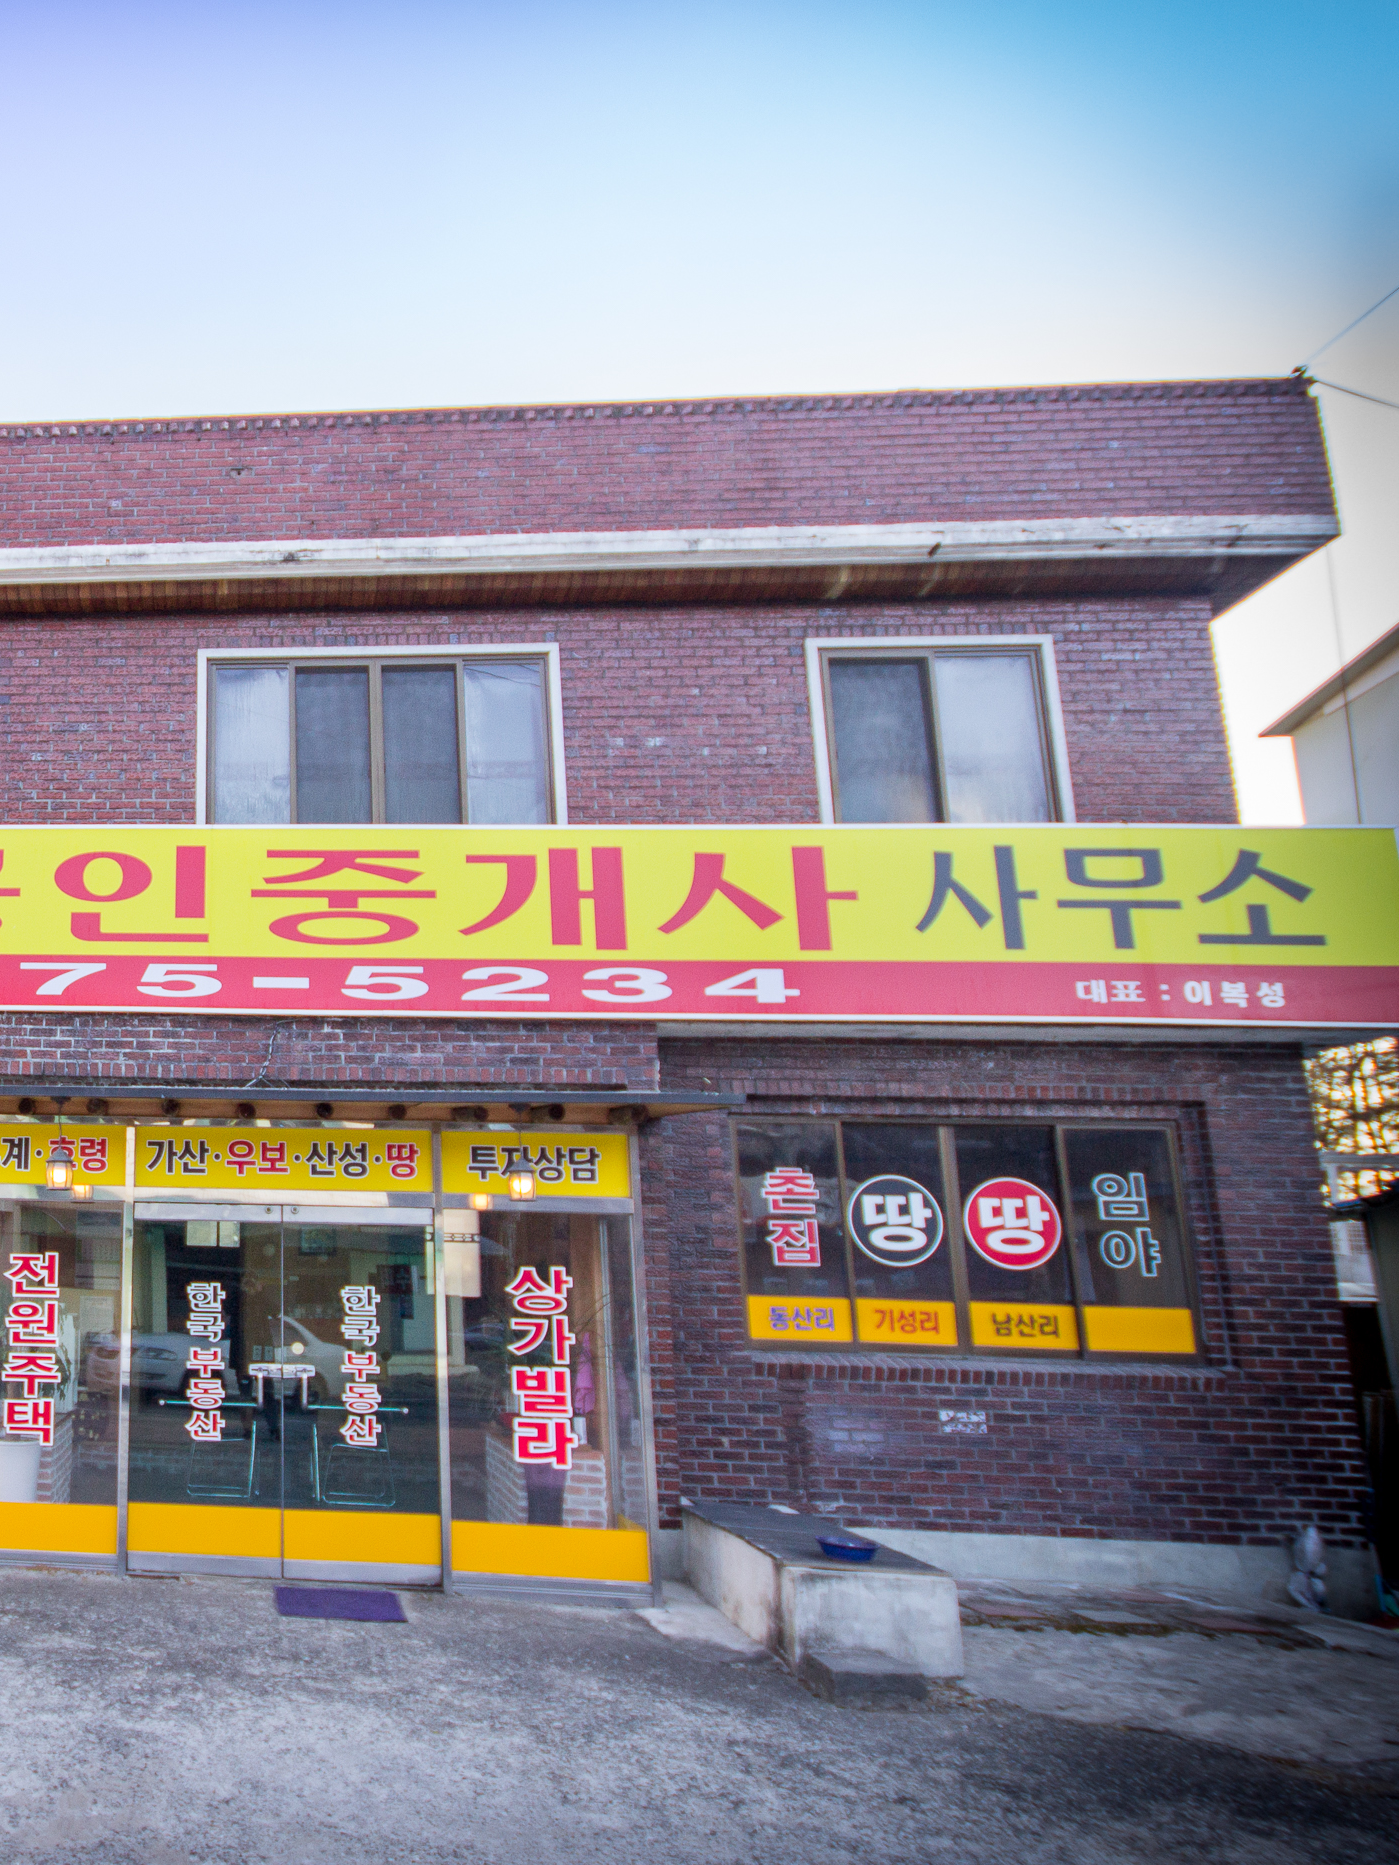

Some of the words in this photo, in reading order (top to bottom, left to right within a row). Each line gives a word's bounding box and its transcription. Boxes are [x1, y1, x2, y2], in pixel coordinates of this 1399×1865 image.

[915, 844, 1327, 950] 사무소
[1075, 979, 1146, 1004] 대표
[762, 1166, 821, 1267] 촌집
[862, 1192, 932, 1251] 땅
[978, 1195, 1049, 1254] 땅
[1091, 1172, 1161, 1277] 임야
[2, 1251, 61, 1446] 전원주택
[769, 1306, 835, 1332] 동산리
[874, 1308, 941, 1335] 기성리
[992, 1312, 1060, 1339] 남산리
